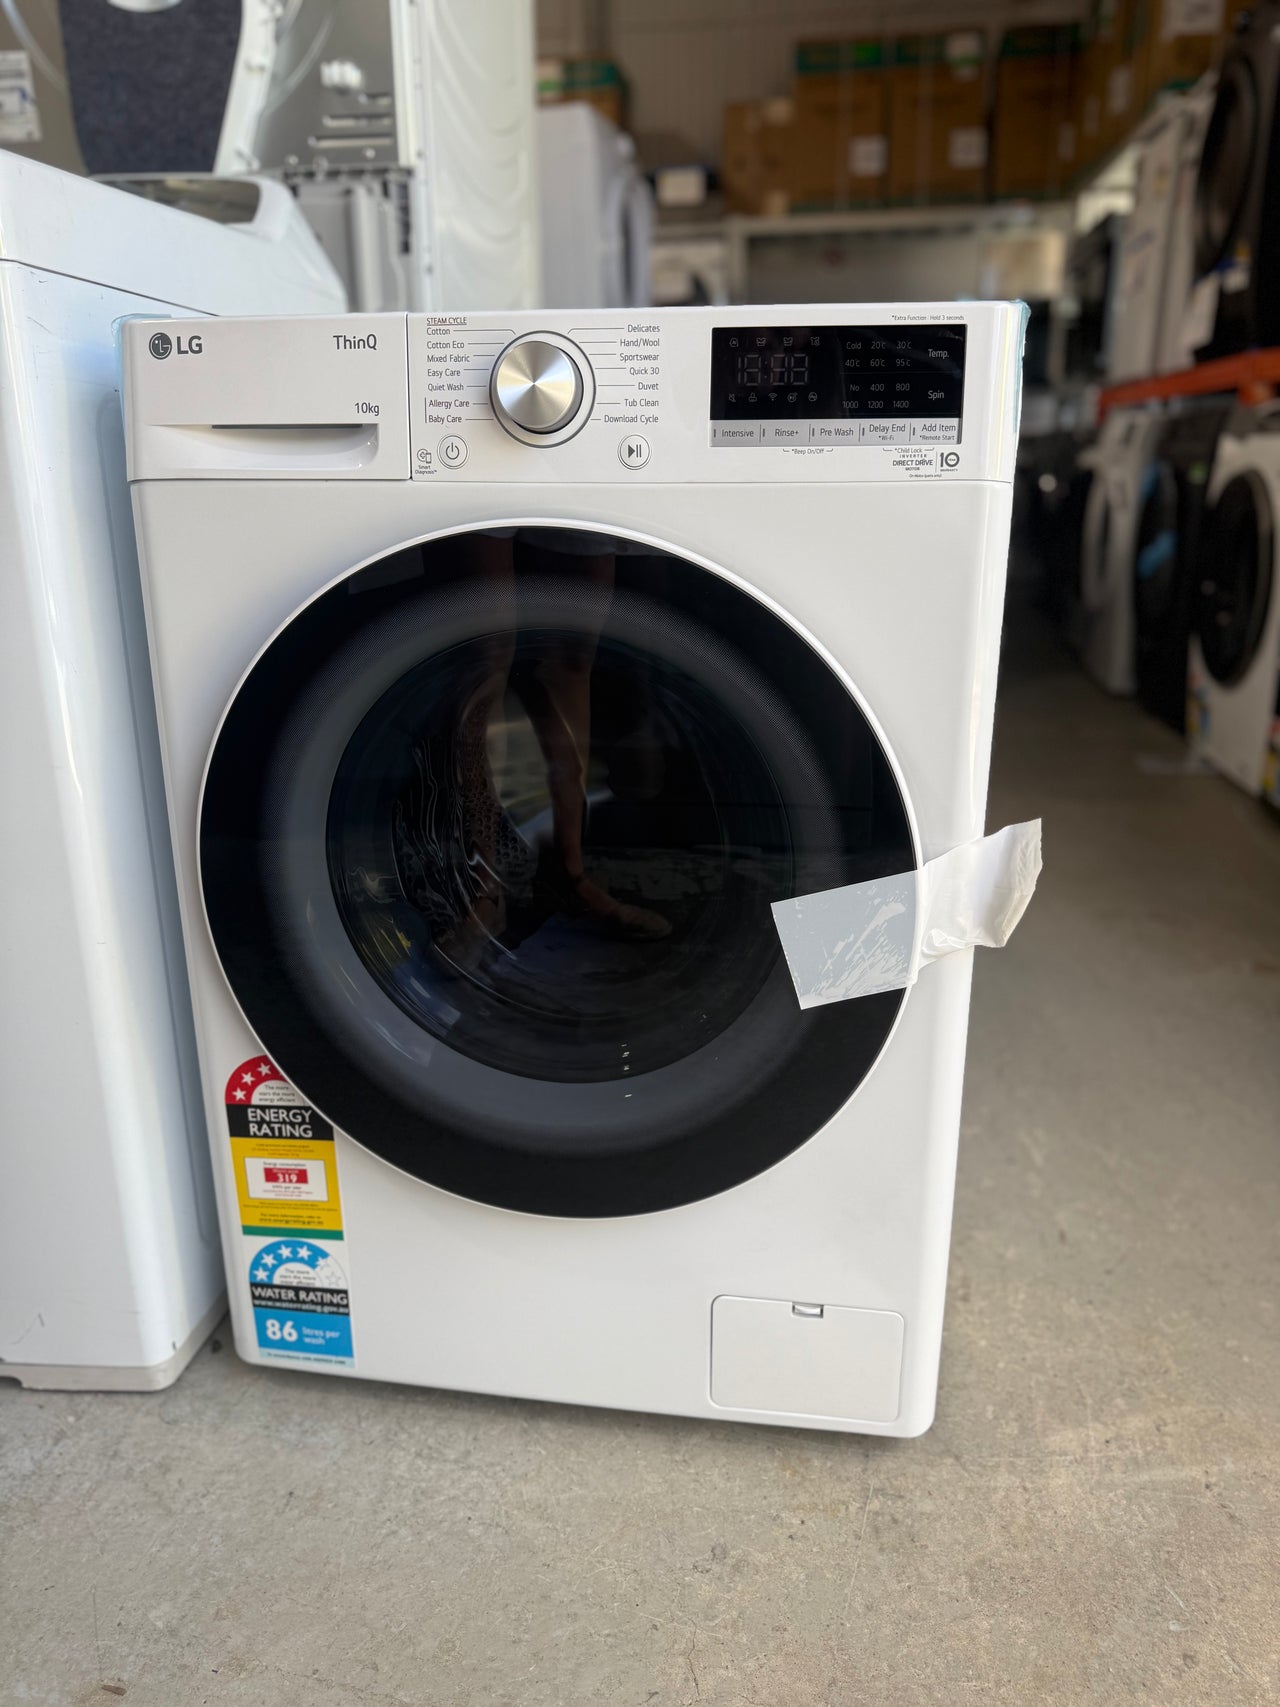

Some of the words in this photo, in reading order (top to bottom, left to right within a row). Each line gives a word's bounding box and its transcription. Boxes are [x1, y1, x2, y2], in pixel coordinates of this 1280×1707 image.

[426, 328, 450, 336] Cotton
[628, 324, 660, 332] Delicates
[176, 335, 203, 355] LG
[333, 334, 378, 350] ThinQ
[426, 341, 450, 349] Cotton
[452, 340, 464, 348] Eco
[620, 338, 660, 347] Hand/Wool
[846, 342, 861, 350] Cold
[426, 354, 447, 362] Mixed
[450, 354, 470, 362] Fabric
[620, 353, 660, 362] Sportswear
[928, 349, 950, 359] Temp.
[428, 369, 444, 378] Easy
[444, 368, 460, 376] Care
[630, 367, 648, 376] Quick
[650, 367, 660, 375] 30
[428, 384, 446, 392] Quiet
[638, 382, 659, 390] Duvet
[896, 383, 910, 391] 800
[928, 390, 944, 400] Spin
[428, 400, 452, 410] Allergy
[454, 400, 470, 408] Care
[624, 398, 638, 407] Tub
[640, 398, 660, 407] Clean
[842, 400, 858, 408] 1000
[868, 400, 884, 408] 1200
[893, 400, 910, 408] 1400
[354, 402, 380, 416] 10kg
[428, 414, 445, 424] Baby
[446, 414, 462, 422] Care
[604, 414, 638, 422] Download
[640, 414, 659, 425] Cycle
[774, 428, 799, 436] Rinse+
[820, 428, 832, 436] Pre
[834, 428, 854, 436] Wash
[869, 424, 890, 434] Delay
[892, 424, 906, 432] End
[922, 424, 937, 432] Add
[939, 424, 956, 432] Item
[722, 429, 754, 438] Intensive
[914, 458, 934, 466] DRIVE
[248, 1108, 312, 1123] ENERGY
[249, 1123, 312, 1138] RATING
[277, 1174, 298, 1183] 319
[252, 1286, 296, 1300] WATER
[298, 1290, 348, 1305] RATING
[266, 1318, 298, 1342] 86
[325, 1330, 340, 1339] per
[303, 1337, 326, 1345] wash
